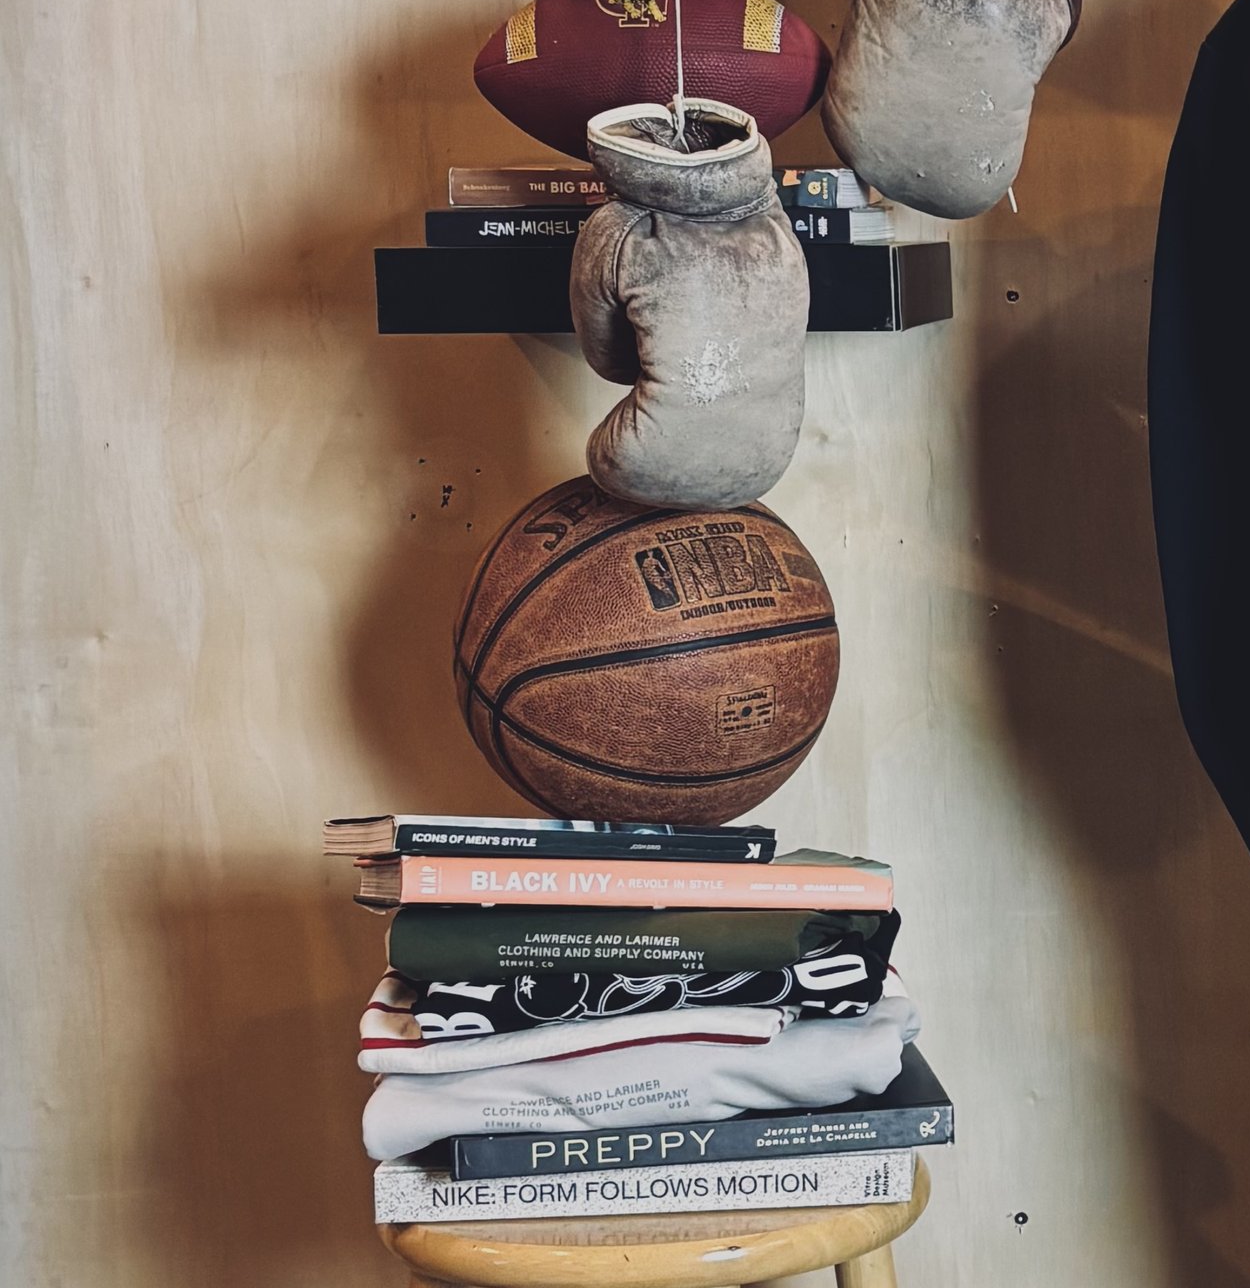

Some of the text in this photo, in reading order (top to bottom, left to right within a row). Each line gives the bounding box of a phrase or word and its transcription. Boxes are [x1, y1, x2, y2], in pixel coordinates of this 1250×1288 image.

[528, 182, 546, 192] THE
[550, 181, 576, 194] BIG
[478, 220, 575, 237] JEAN-MICHEL
[666, 534, 791, 603] NBA
[412, 832, 537, 847] ICONS OF MEN'S STYLE
[471, 870, 725, 894] BLACK IVY A REVOLT IN STYLE
[524, 933, 680, 947] LAWRENCE AND LARIMER
[498, 945, 705, 961] CLOTHING AND SUPPLY COMPANY
[482, 1107, 549, 1118] CLOTHING
[578, 1101, 624, 1117] SUPPLY
[628, 1088, 689, 1107] COMPANY
[575, 1091, 602, 1104] AND
[606, 1079, 661, 1099] LARIMER
[531, 1128, 715, 1169] PREPPY
[432, 1172, 819, 1207] NIKE: FORM FOLLOWS MOTION
